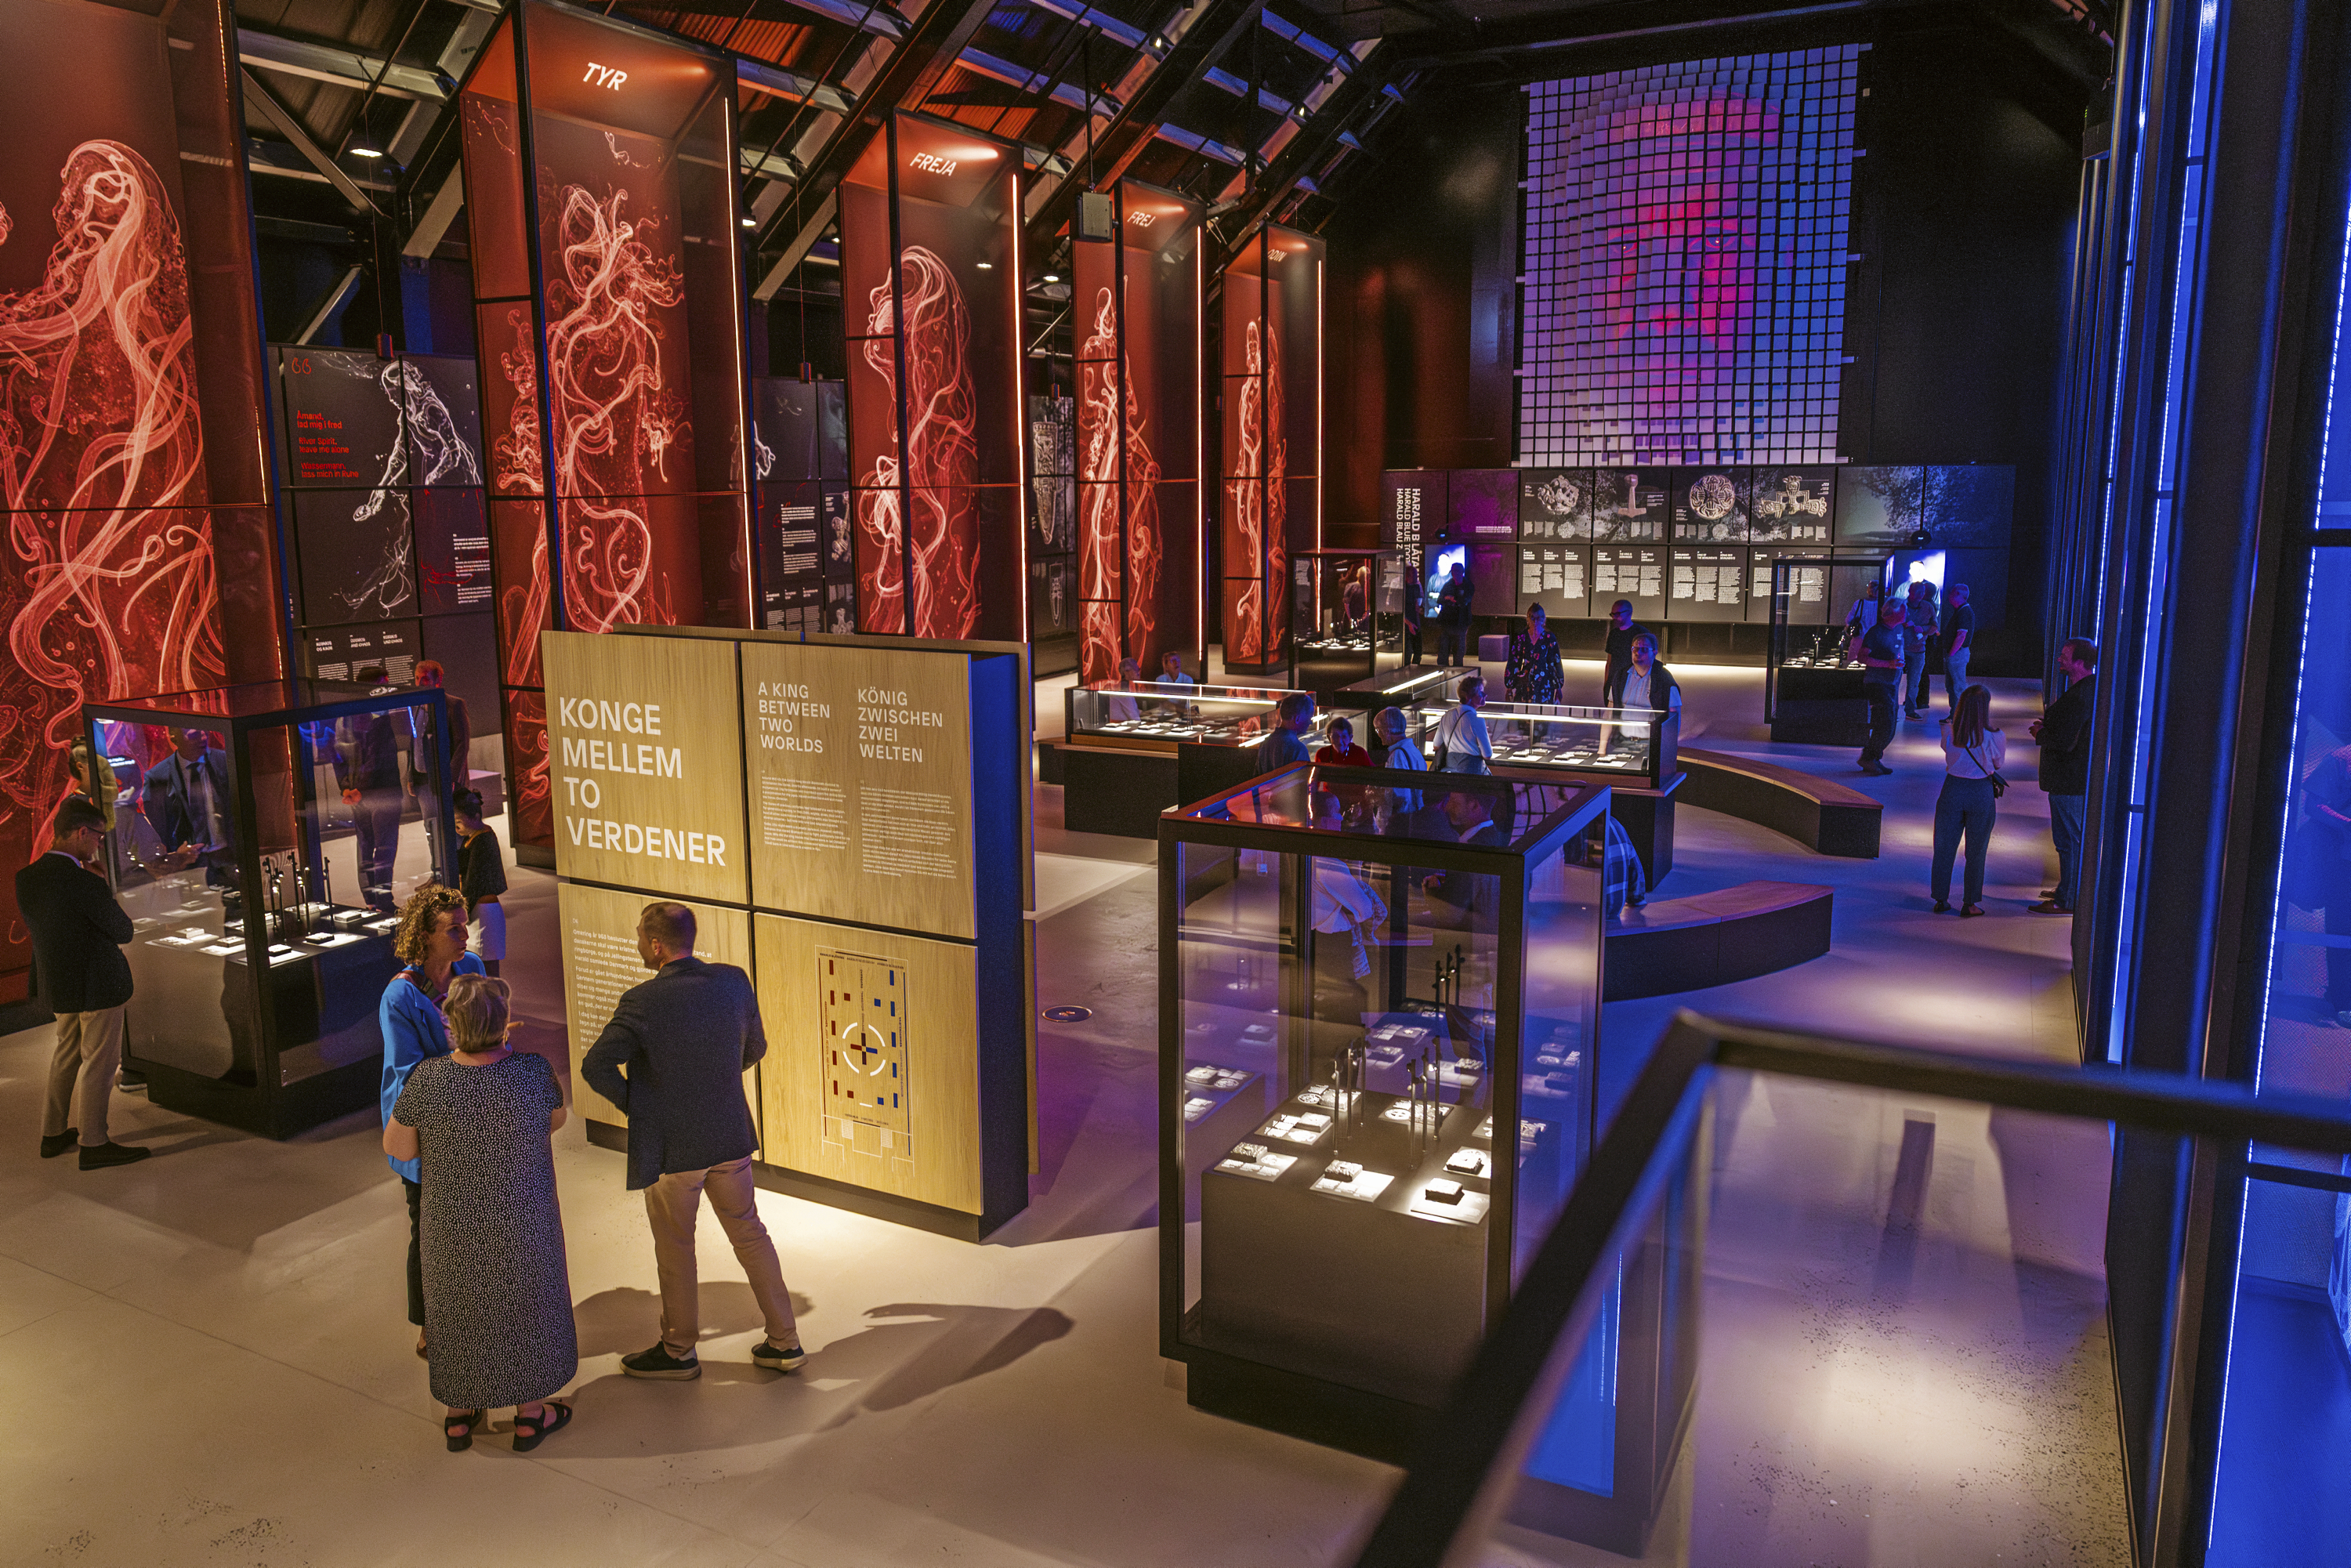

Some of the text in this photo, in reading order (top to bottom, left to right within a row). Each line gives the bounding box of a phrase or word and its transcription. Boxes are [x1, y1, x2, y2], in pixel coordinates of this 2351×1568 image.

[582, 61, 627, 91] TYR
[909, 152, 957, 176] FREJA
[1127, 211, 1156, 227] FREJ
[1267, 248, 1288, 263] ODIN
[310, 421, 323, 430] mig
[328, 421, 342, 429] fred
[1412, 488, 1421, 531] HARALD
[758, 682, 809, 699] A KING
[858, 686, 907, 706] KÖNIG
[560, 697, 661, 736] KONGE
[759, 699, 830, 719] BETWEEN
[858, 707, 943, 727] ZWISCHEN
[759, 717, 793, 733] TWO
[858, 725, 897, 742] ZWEI
[760, 734, 824, 754] WORLDS
[859, 743, 923, 763] WELTEN
[562, 737, 683, 779] MELLEM
[563, 776, 600, 809] TO
[566, 816, 726, 867] VERDENER
[573, 929, 592, 938] Omkring
[607, 934, 629, 943] beslutter
[609, 961, 629, 969] Danmark
